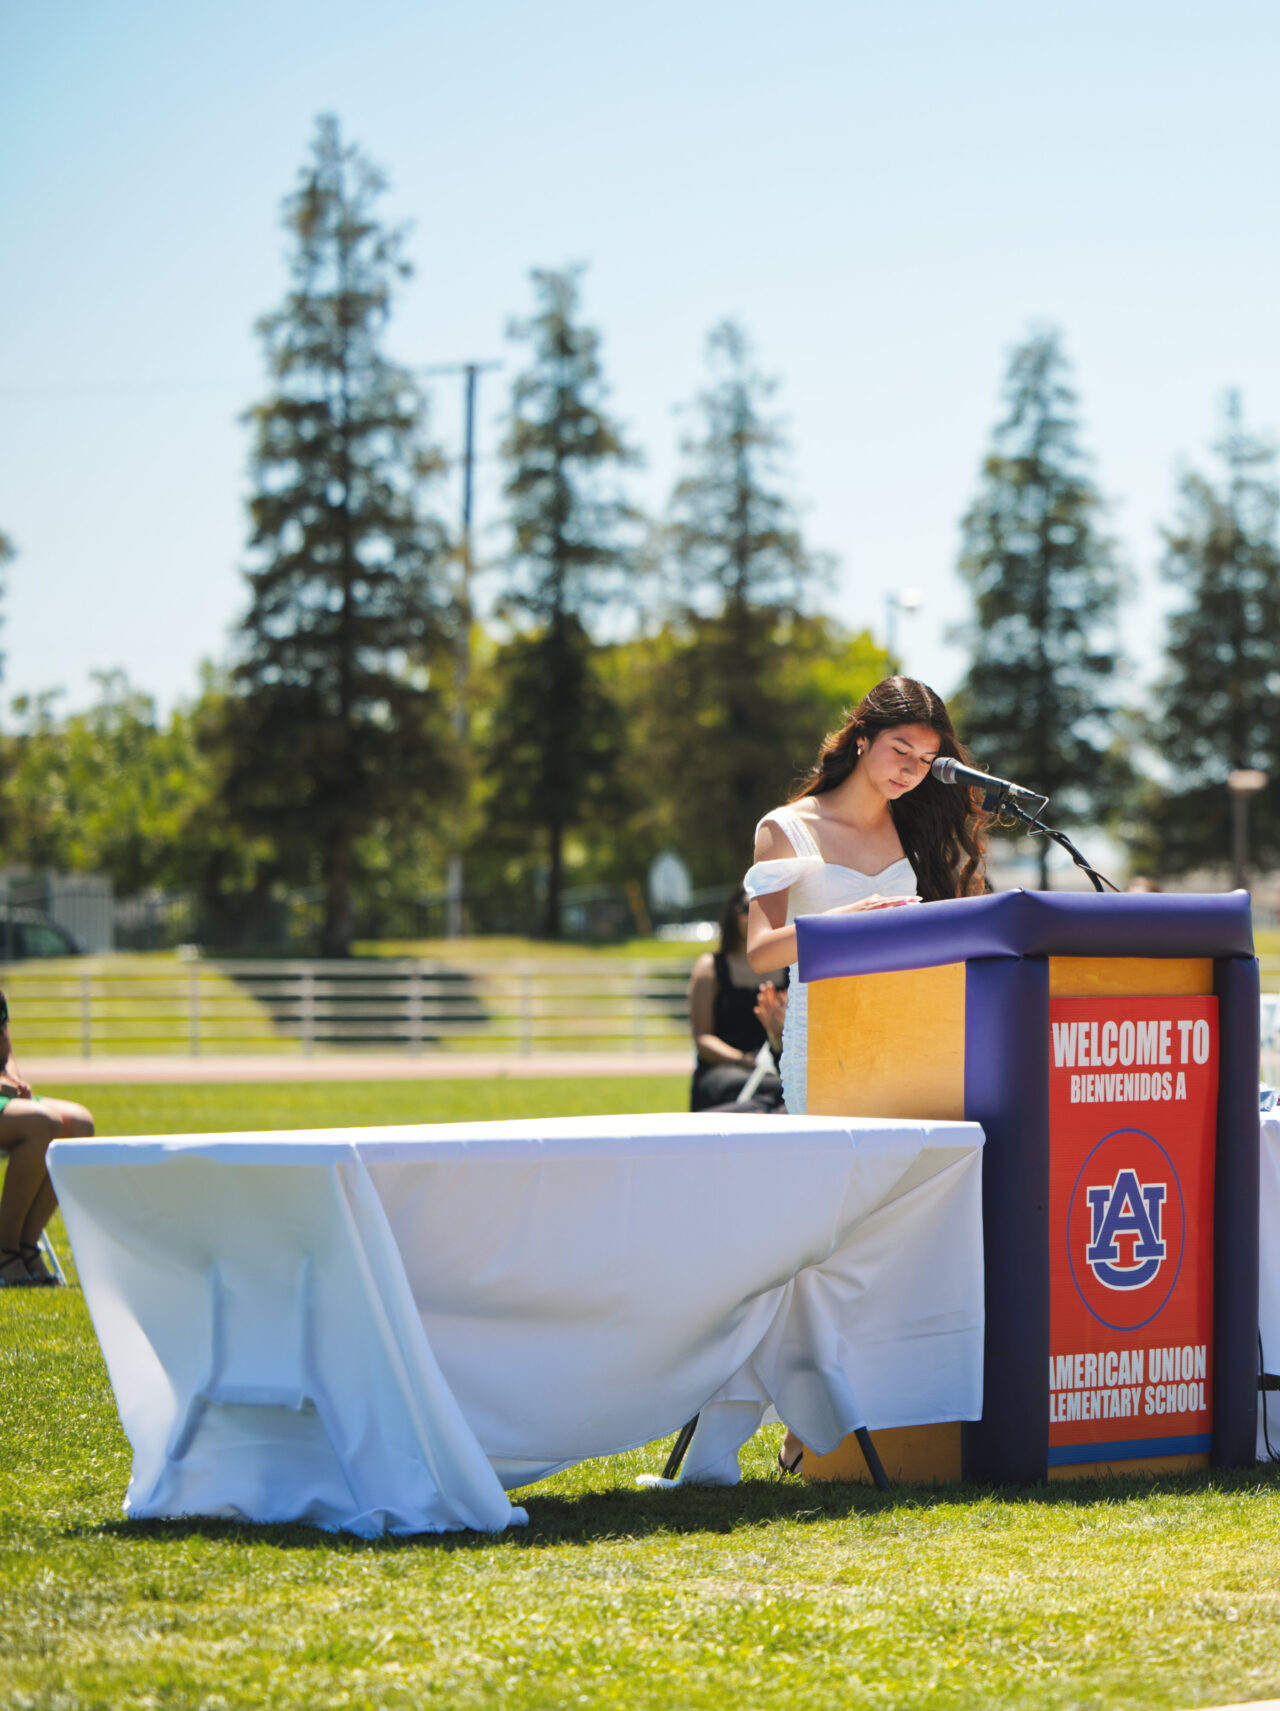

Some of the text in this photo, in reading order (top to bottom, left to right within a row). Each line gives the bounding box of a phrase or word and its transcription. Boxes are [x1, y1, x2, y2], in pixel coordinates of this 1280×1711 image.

[1052, 1019, 1210, 1068] WELCOME TO
[1070, 1071, 1187, 1104] BIENVENIDOS A
[1149, 1345, 1207, 1383] UNION
[1050, 1382, 1207, 1423] LEMENTARY SCHOOL
